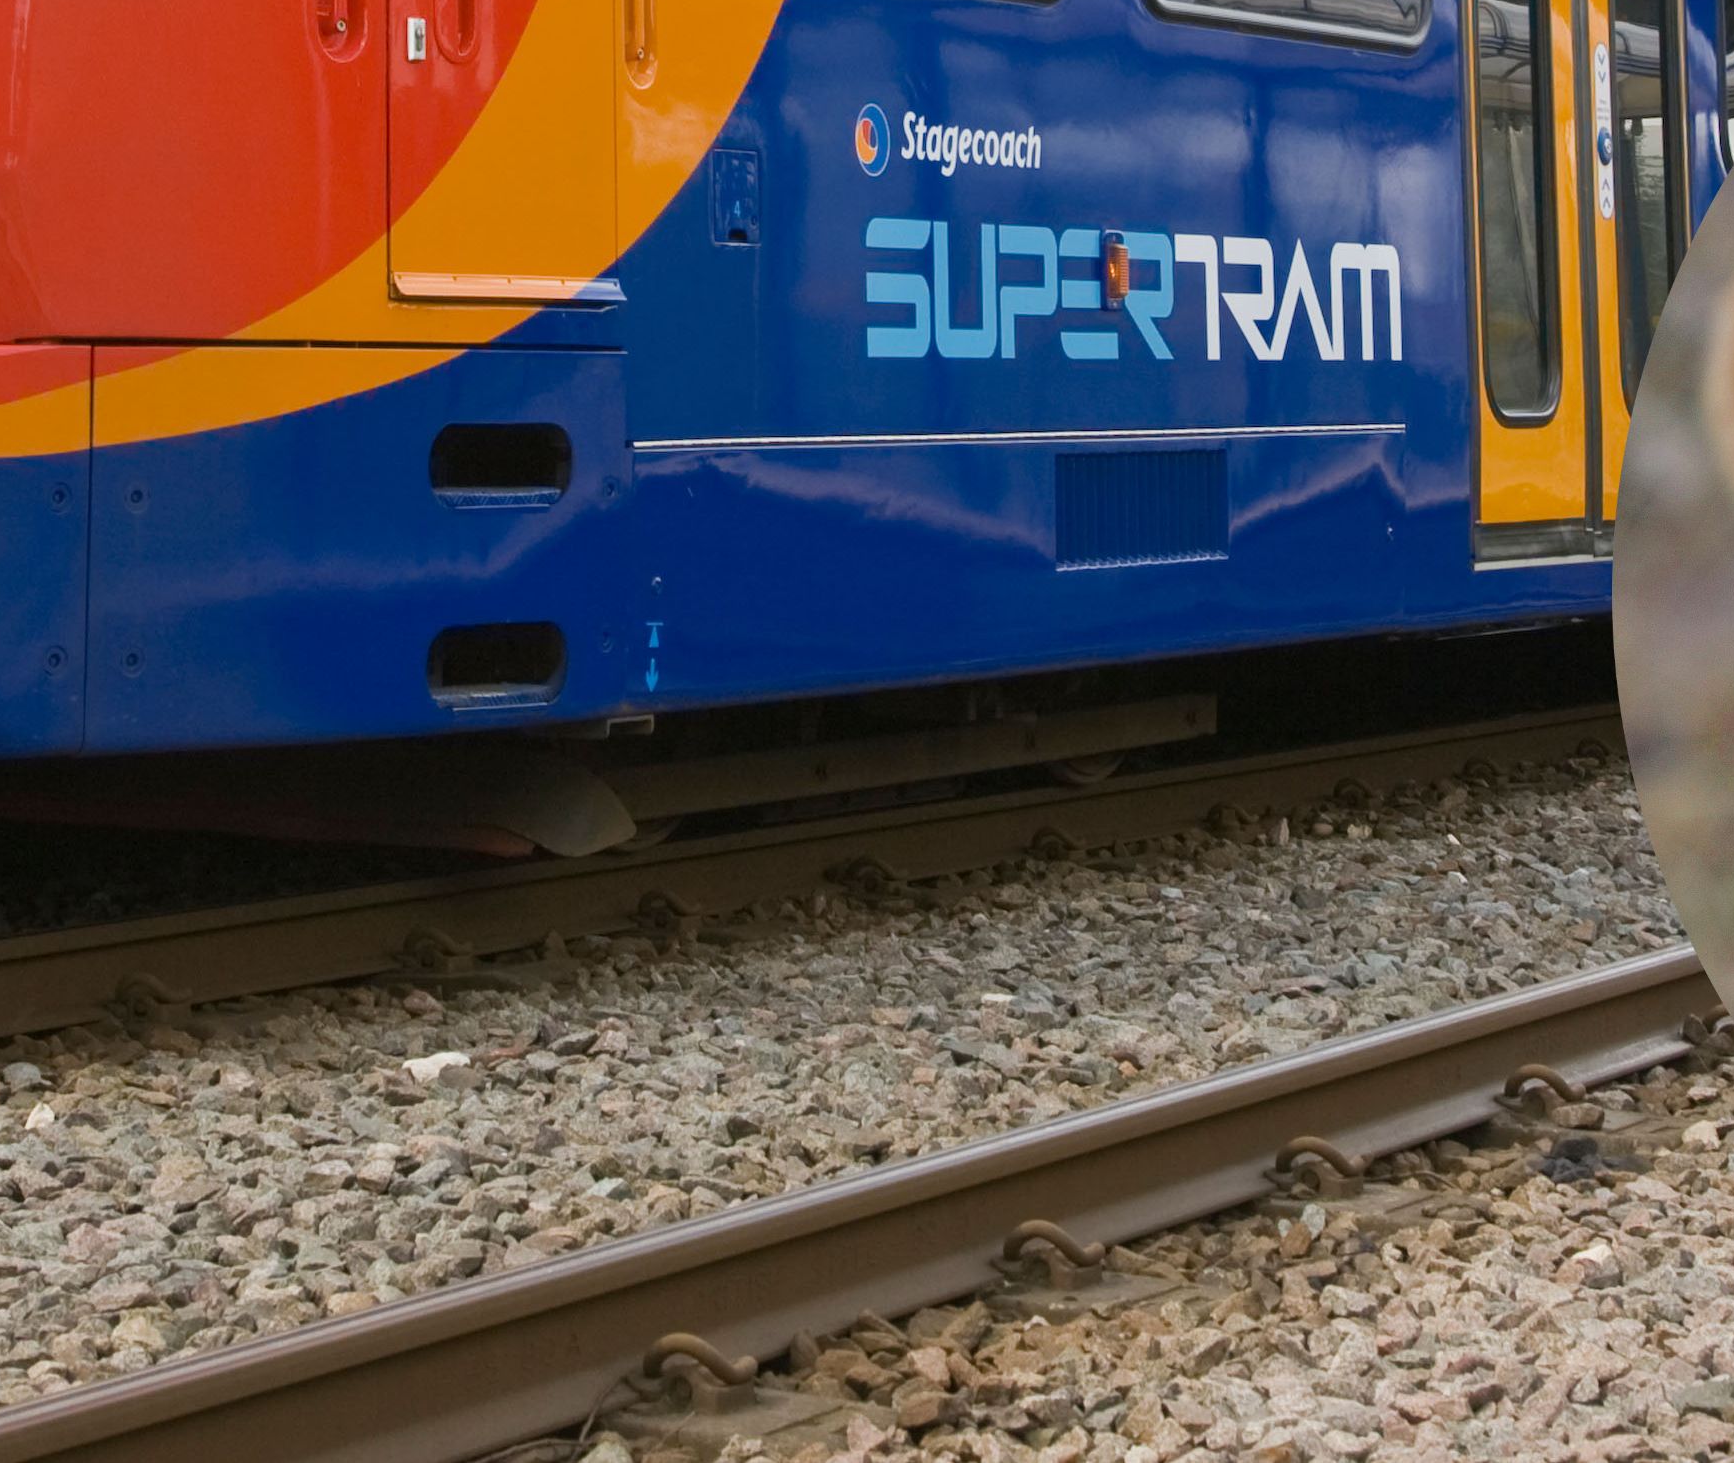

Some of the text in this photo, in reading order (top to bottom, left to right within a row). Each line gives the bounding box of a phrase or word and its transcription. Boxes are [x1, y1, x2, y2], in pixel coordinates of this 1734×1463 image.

[900, 110, 1042, 178] Stagecoach
[733, 200, 741, 218] 4
[866, 216, 1404, 362] SUPERTRAM
